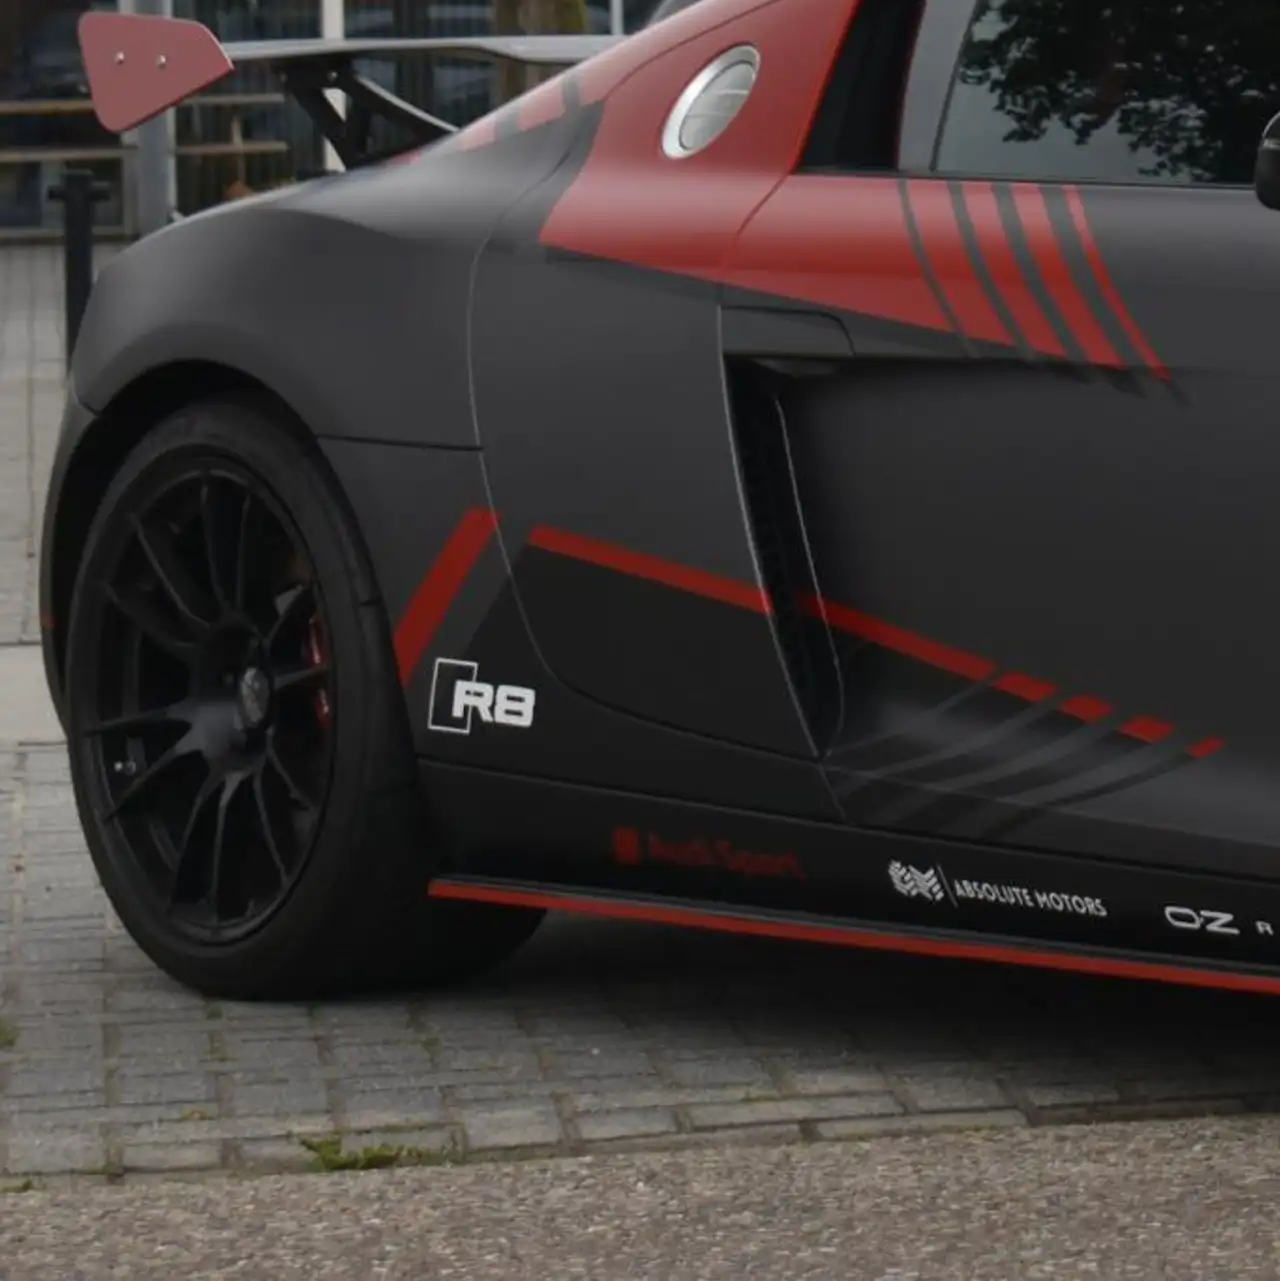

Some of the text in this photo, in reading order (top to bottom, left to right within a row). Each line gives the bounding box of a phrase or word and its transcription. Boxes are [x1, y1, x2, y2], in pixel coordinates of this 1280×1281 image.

[451, 678, 536, 728] R8
[953, 879, 1108, 917] ABSOLUTE MOTORS
[1164, 905, 1241, 935] OZ
